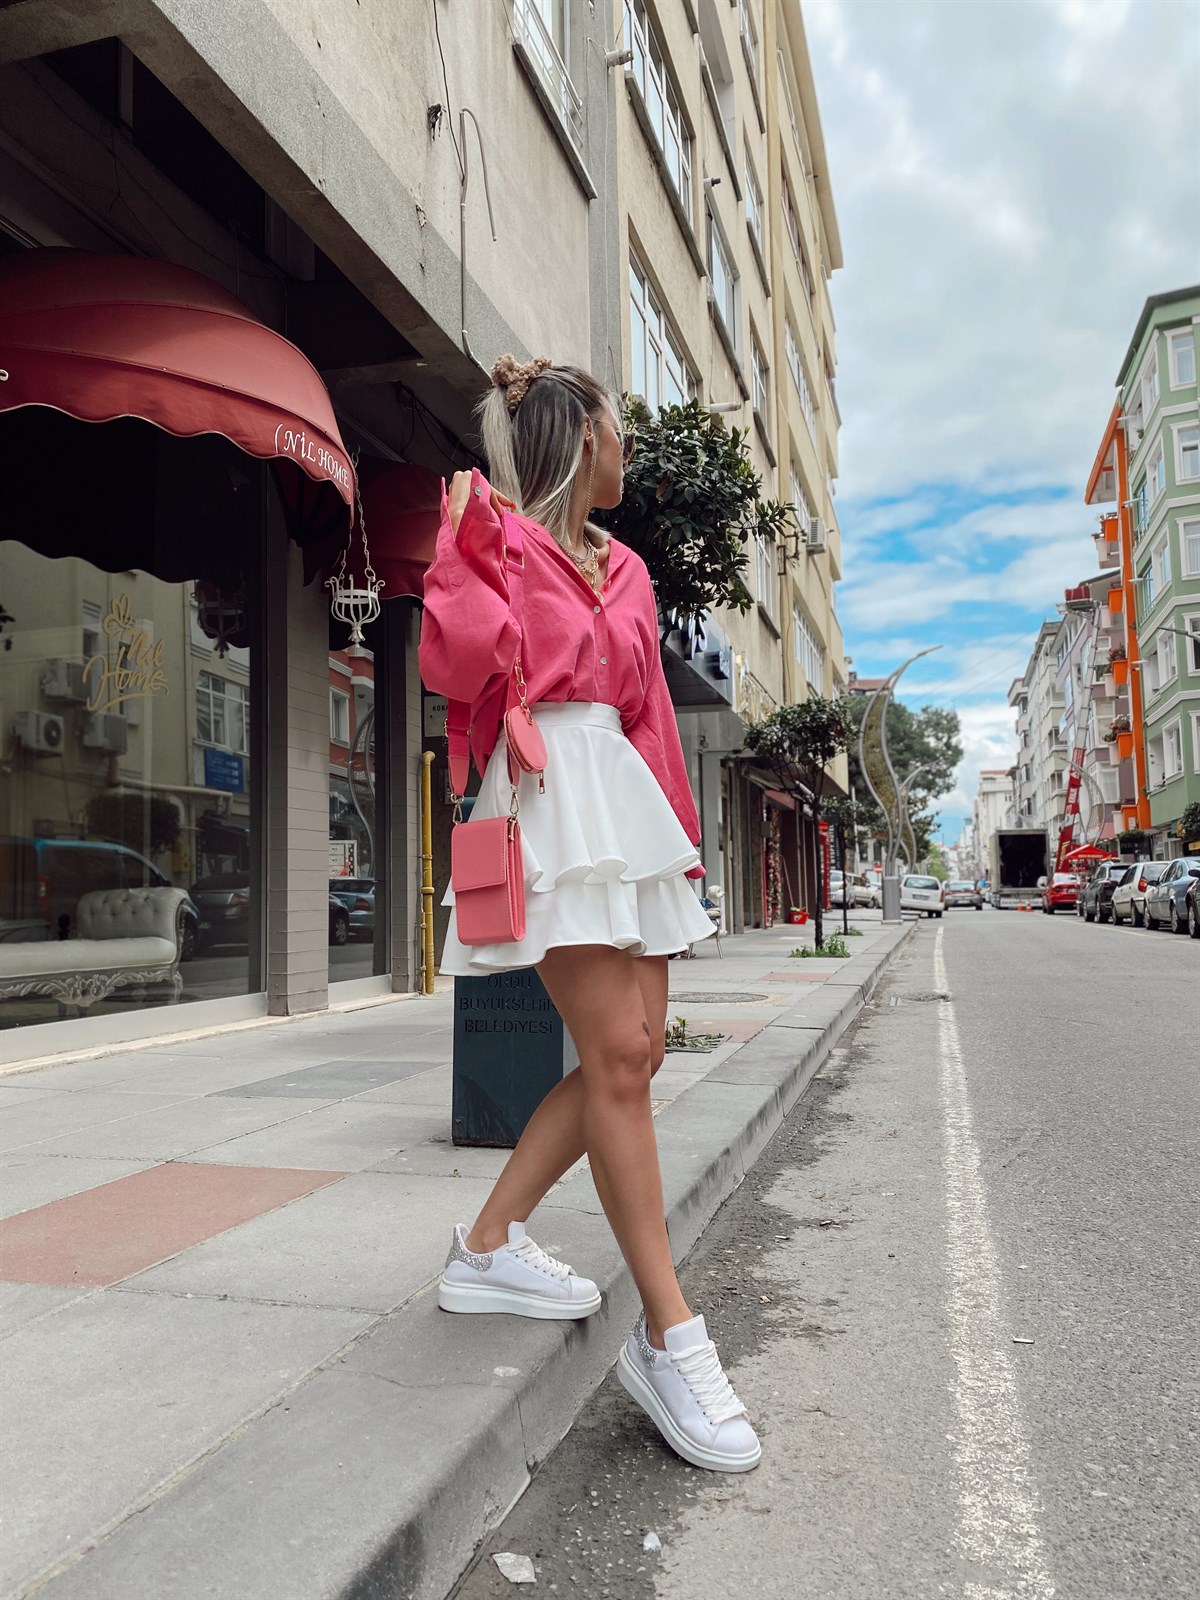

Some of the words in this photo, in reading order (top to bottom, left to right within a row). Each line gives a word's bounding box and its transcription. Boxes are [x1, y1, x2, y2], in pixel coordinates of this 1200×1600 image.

[317, 447, 349, 489] HOME
[81, 646, 170, 711] Home
[487, 975, 531, 989] ORDU
